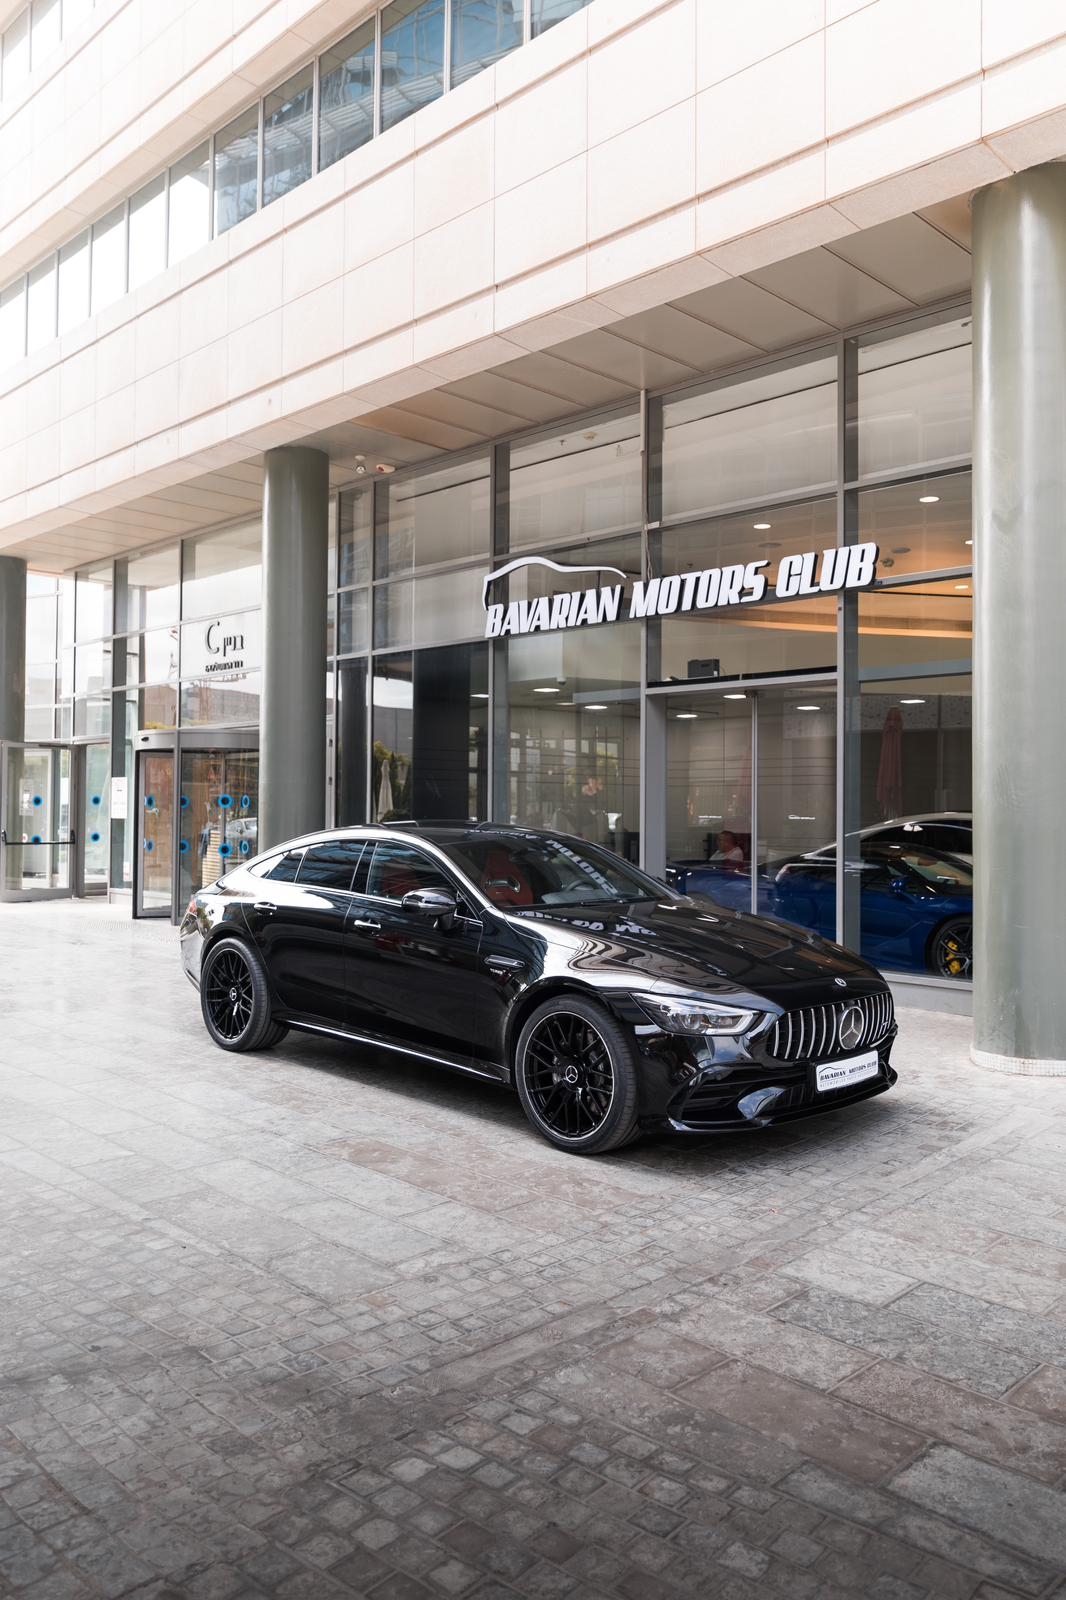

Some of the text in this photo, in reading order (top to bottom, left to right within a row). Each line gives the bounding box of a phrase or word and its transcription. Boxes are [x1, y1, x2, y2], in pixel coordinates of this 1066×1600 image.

[485, 542, 878, 638] BAVARIAN MOTORS CLUB
